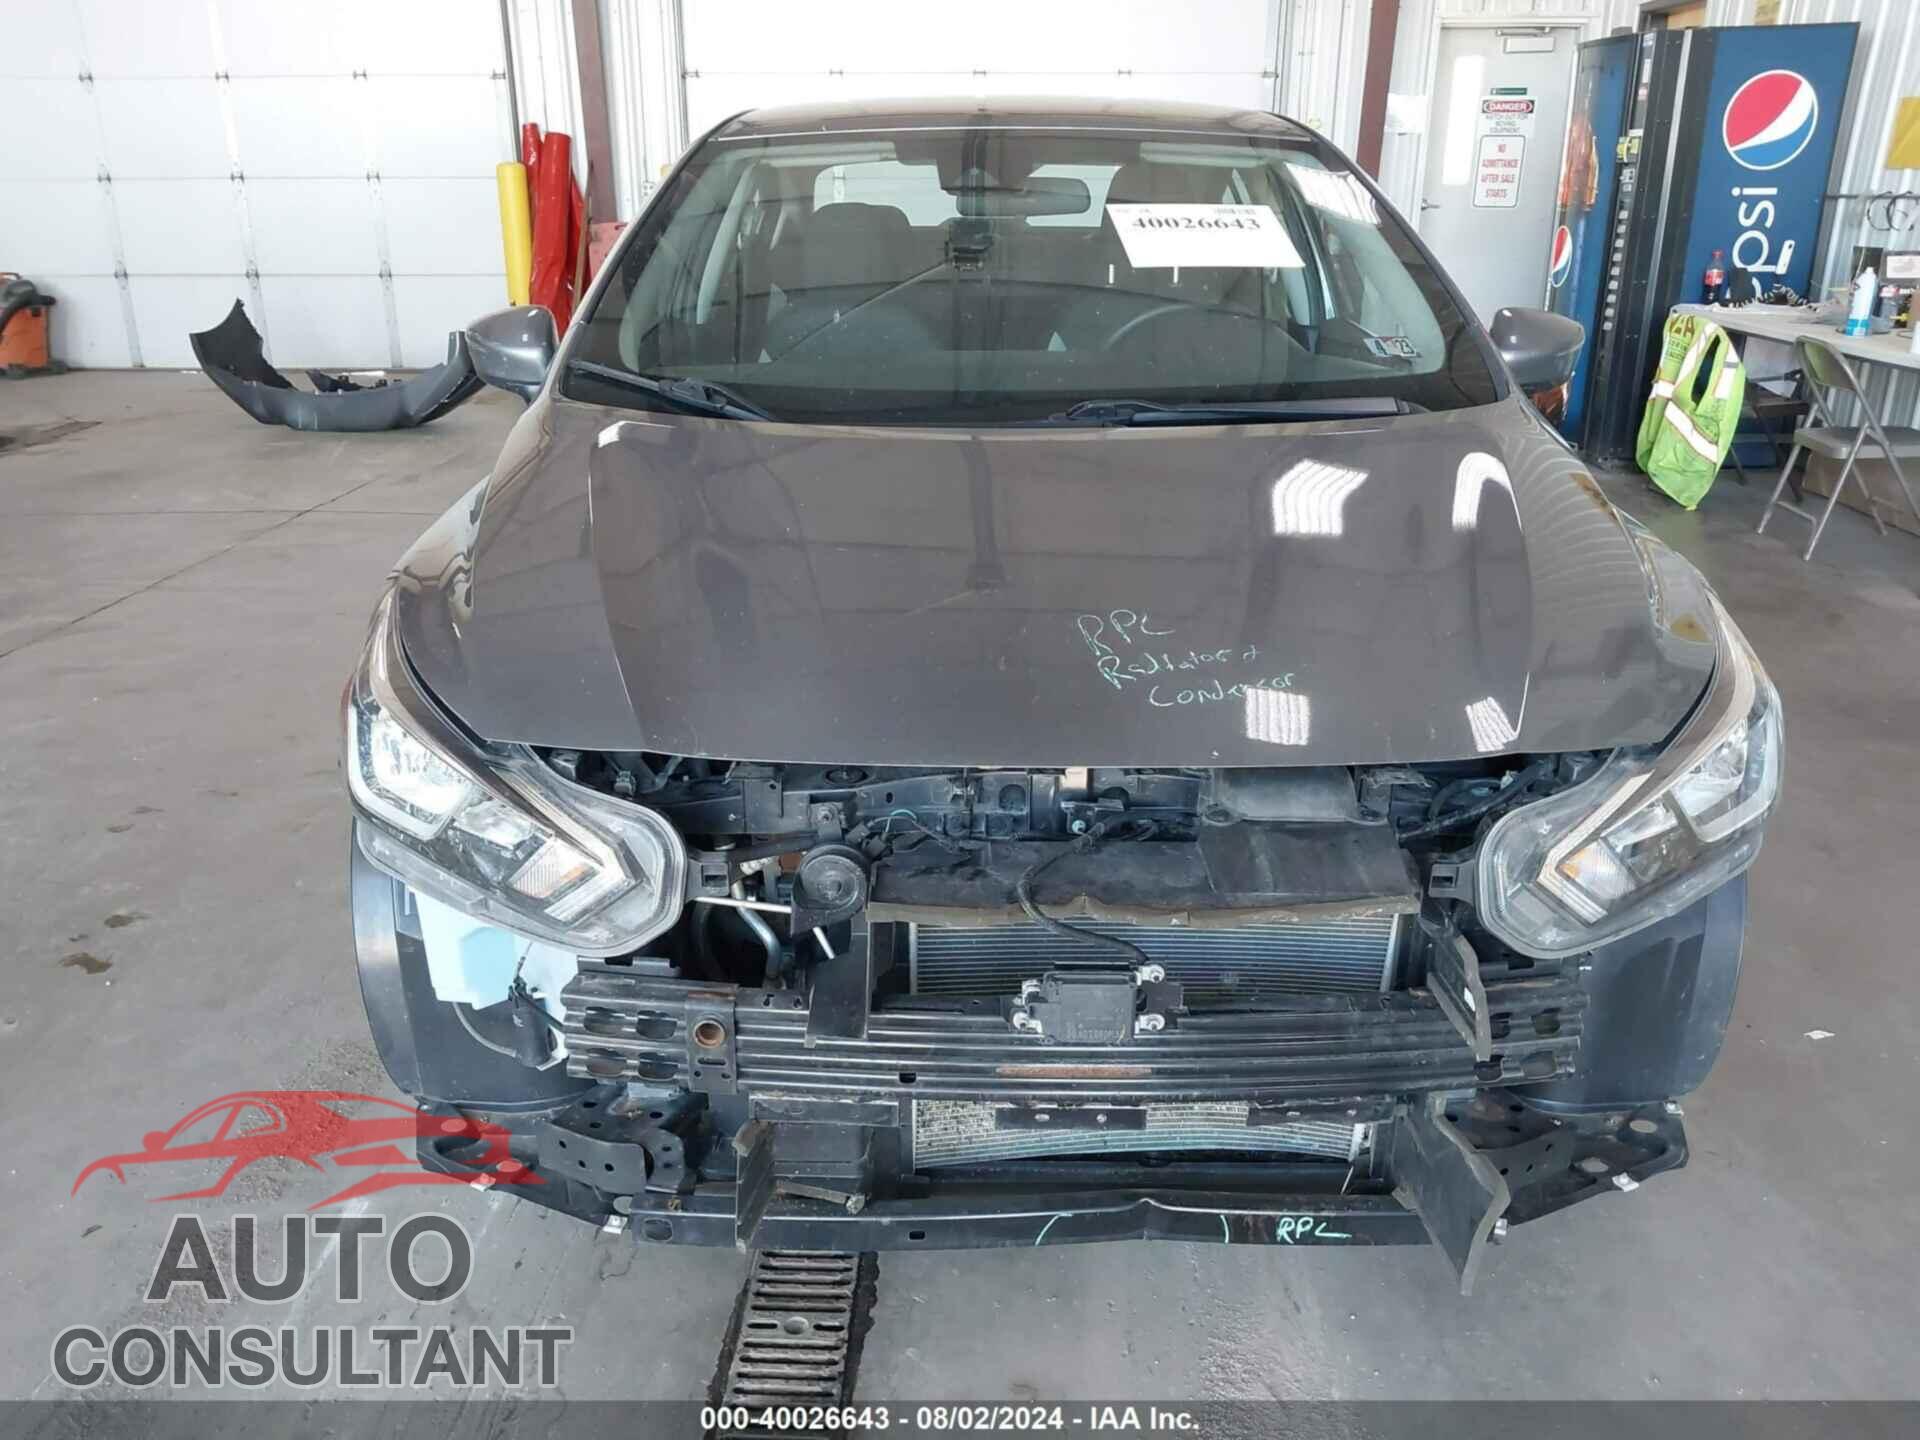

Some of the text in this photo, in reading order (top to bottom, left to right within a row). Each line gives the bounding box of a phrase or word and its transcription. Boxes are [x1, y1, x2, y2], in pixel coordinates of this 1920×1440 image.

[1489, 102, 1527, 111] DANGER
[1482, 159, 1519, 168] ADMITTANCE
[1481, 174, 1515, 183] AFTER SALE
[1132, 217, 1261, 230] 40026643
[1731, 186, 1778, 300] psi
